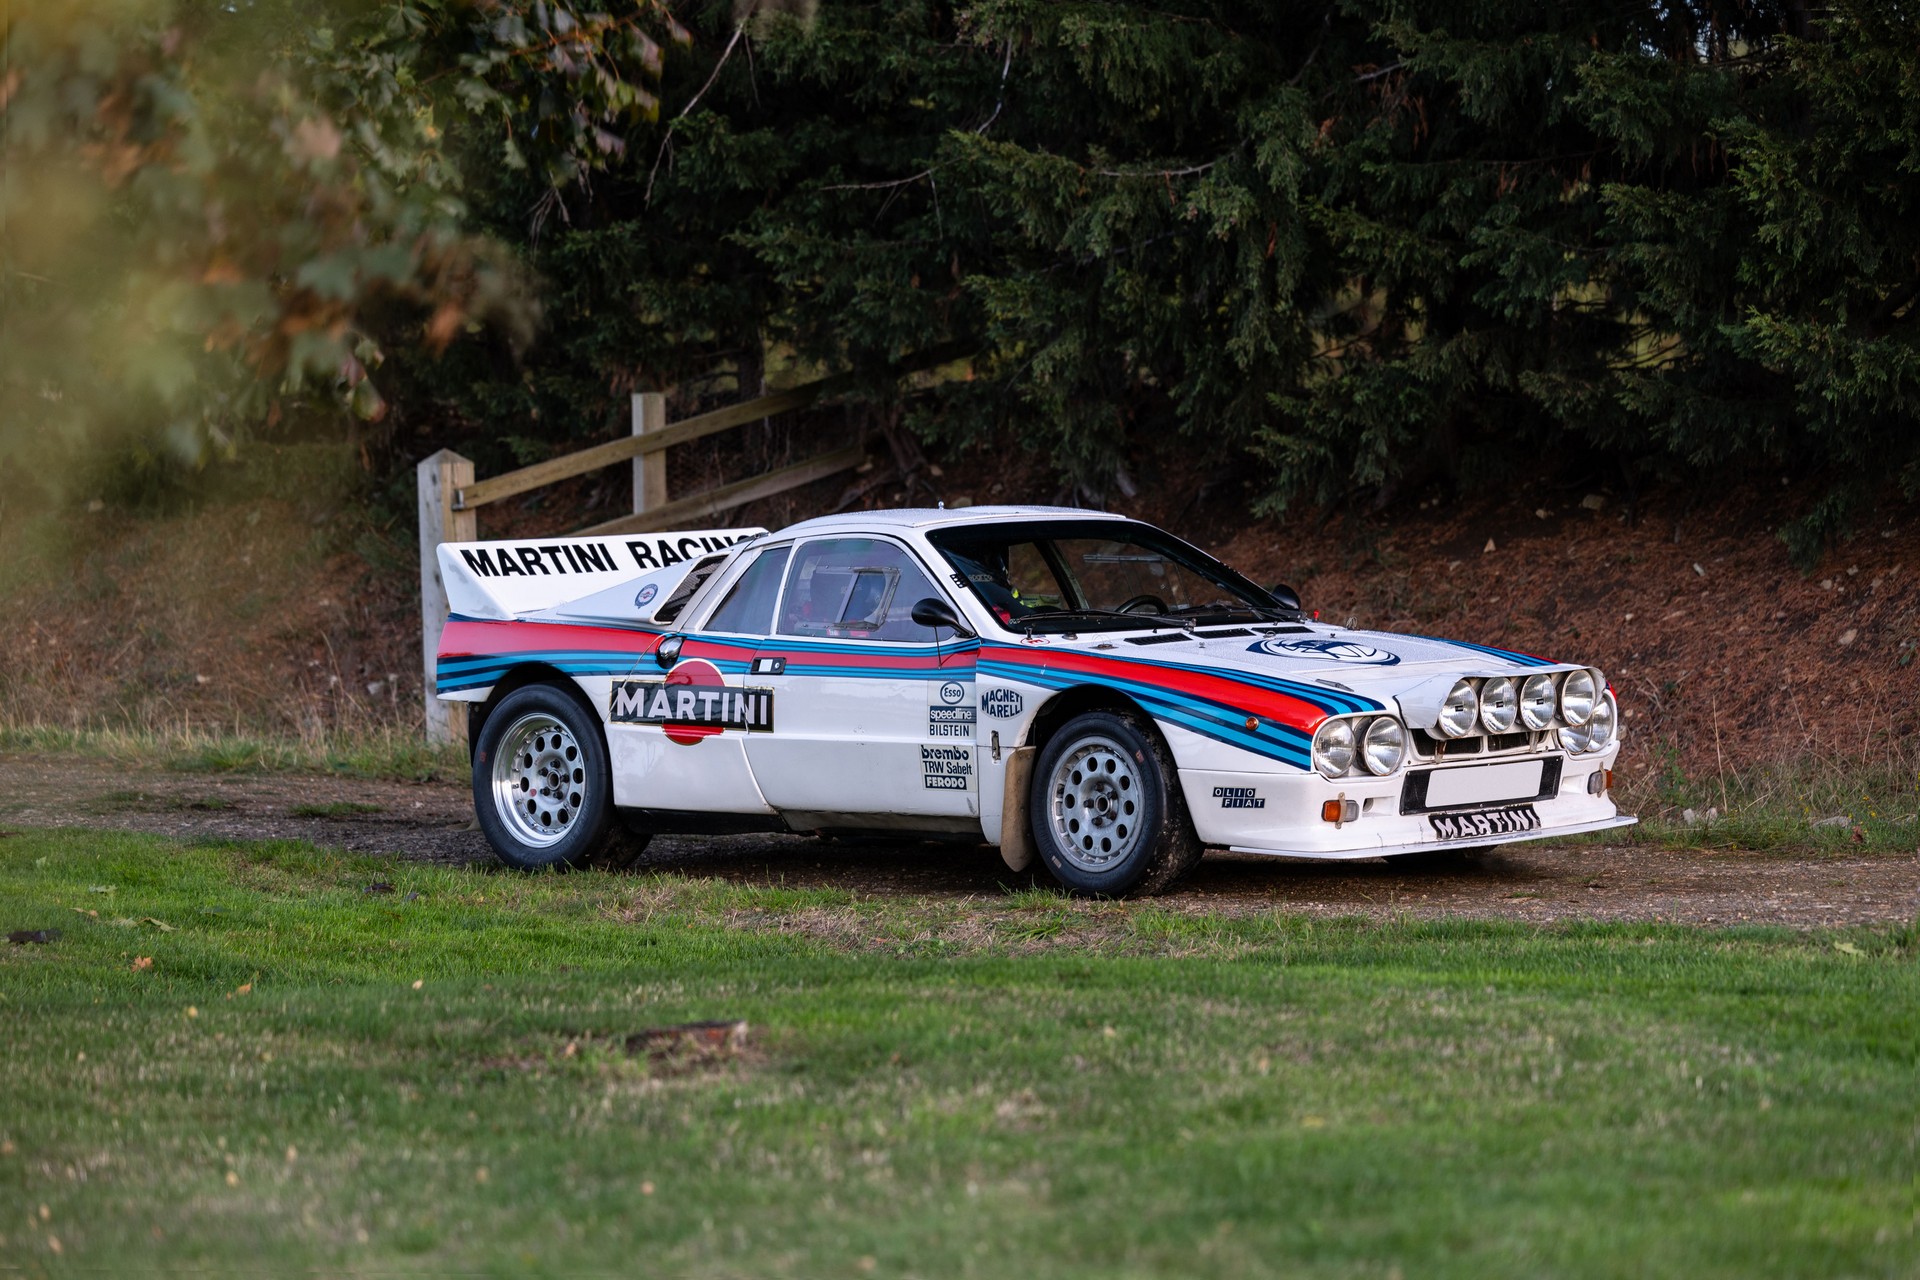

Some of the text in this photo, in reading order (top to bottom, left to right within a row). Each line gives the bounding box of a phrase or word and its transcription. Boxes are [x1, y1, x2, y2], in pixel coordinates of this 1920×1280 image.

[460, 535, 750, 577] MARTINI RACIN
[944, 687, 961, 697] Esso
[616, 687, 768, 725] MARTINI
[930, 708, 972, 721] speedline
[929, 724, 970, 737] BILSTEIN
[921, 745, 969, 761] brembo
[923, 760, 973, 775] TRW Sabelt
[926, 776, 965, 788] FERODO
[1214, 788, 1254, 797] OLIO
[1224, 799, 1263, 807] FIAT
[1434, 809, 1541, 839] MARTINI
